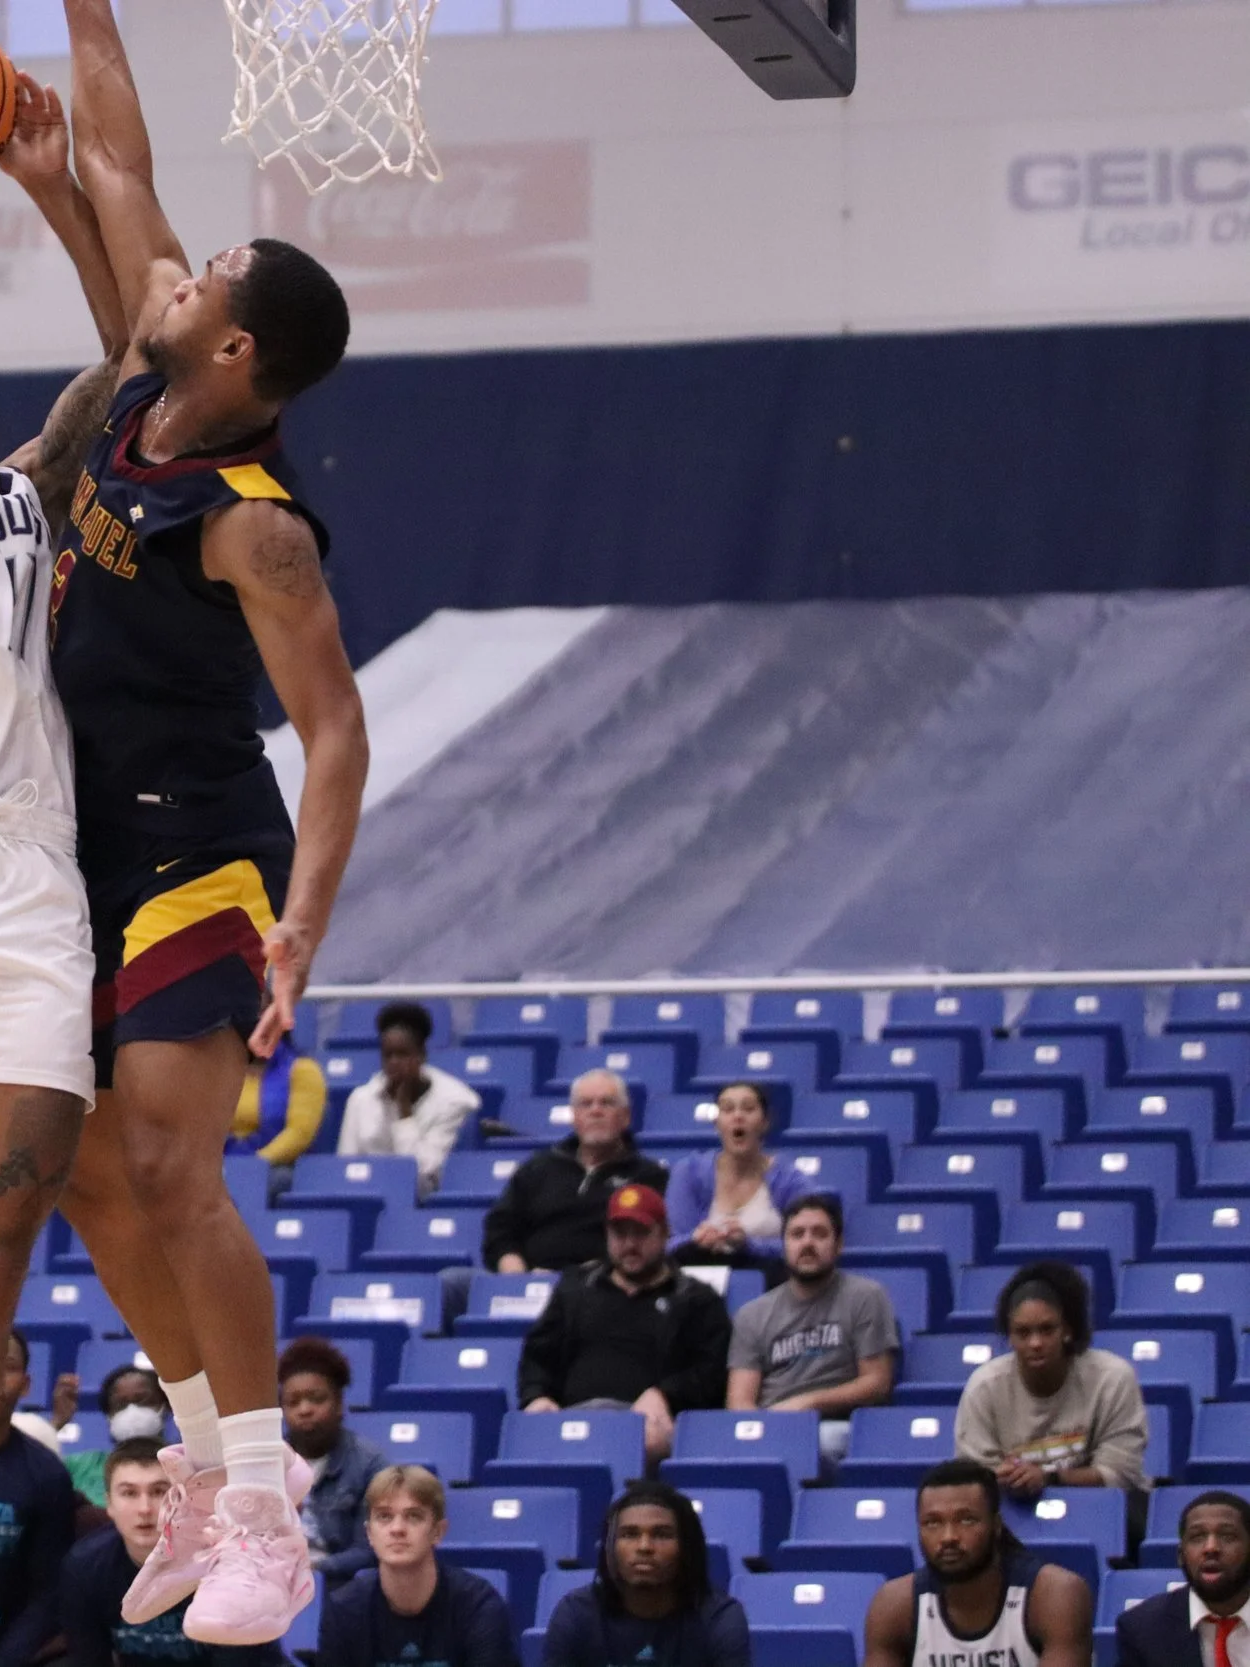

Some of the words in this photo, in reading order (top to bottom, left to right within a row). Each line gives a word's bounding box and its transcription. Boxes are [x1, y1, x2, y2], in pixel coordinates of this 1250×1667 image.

[1080, 212, 1193, 250] Local
[1210, 209, 1250, 246] O
[771, 1323, 842, 1364] AUGUSTA
